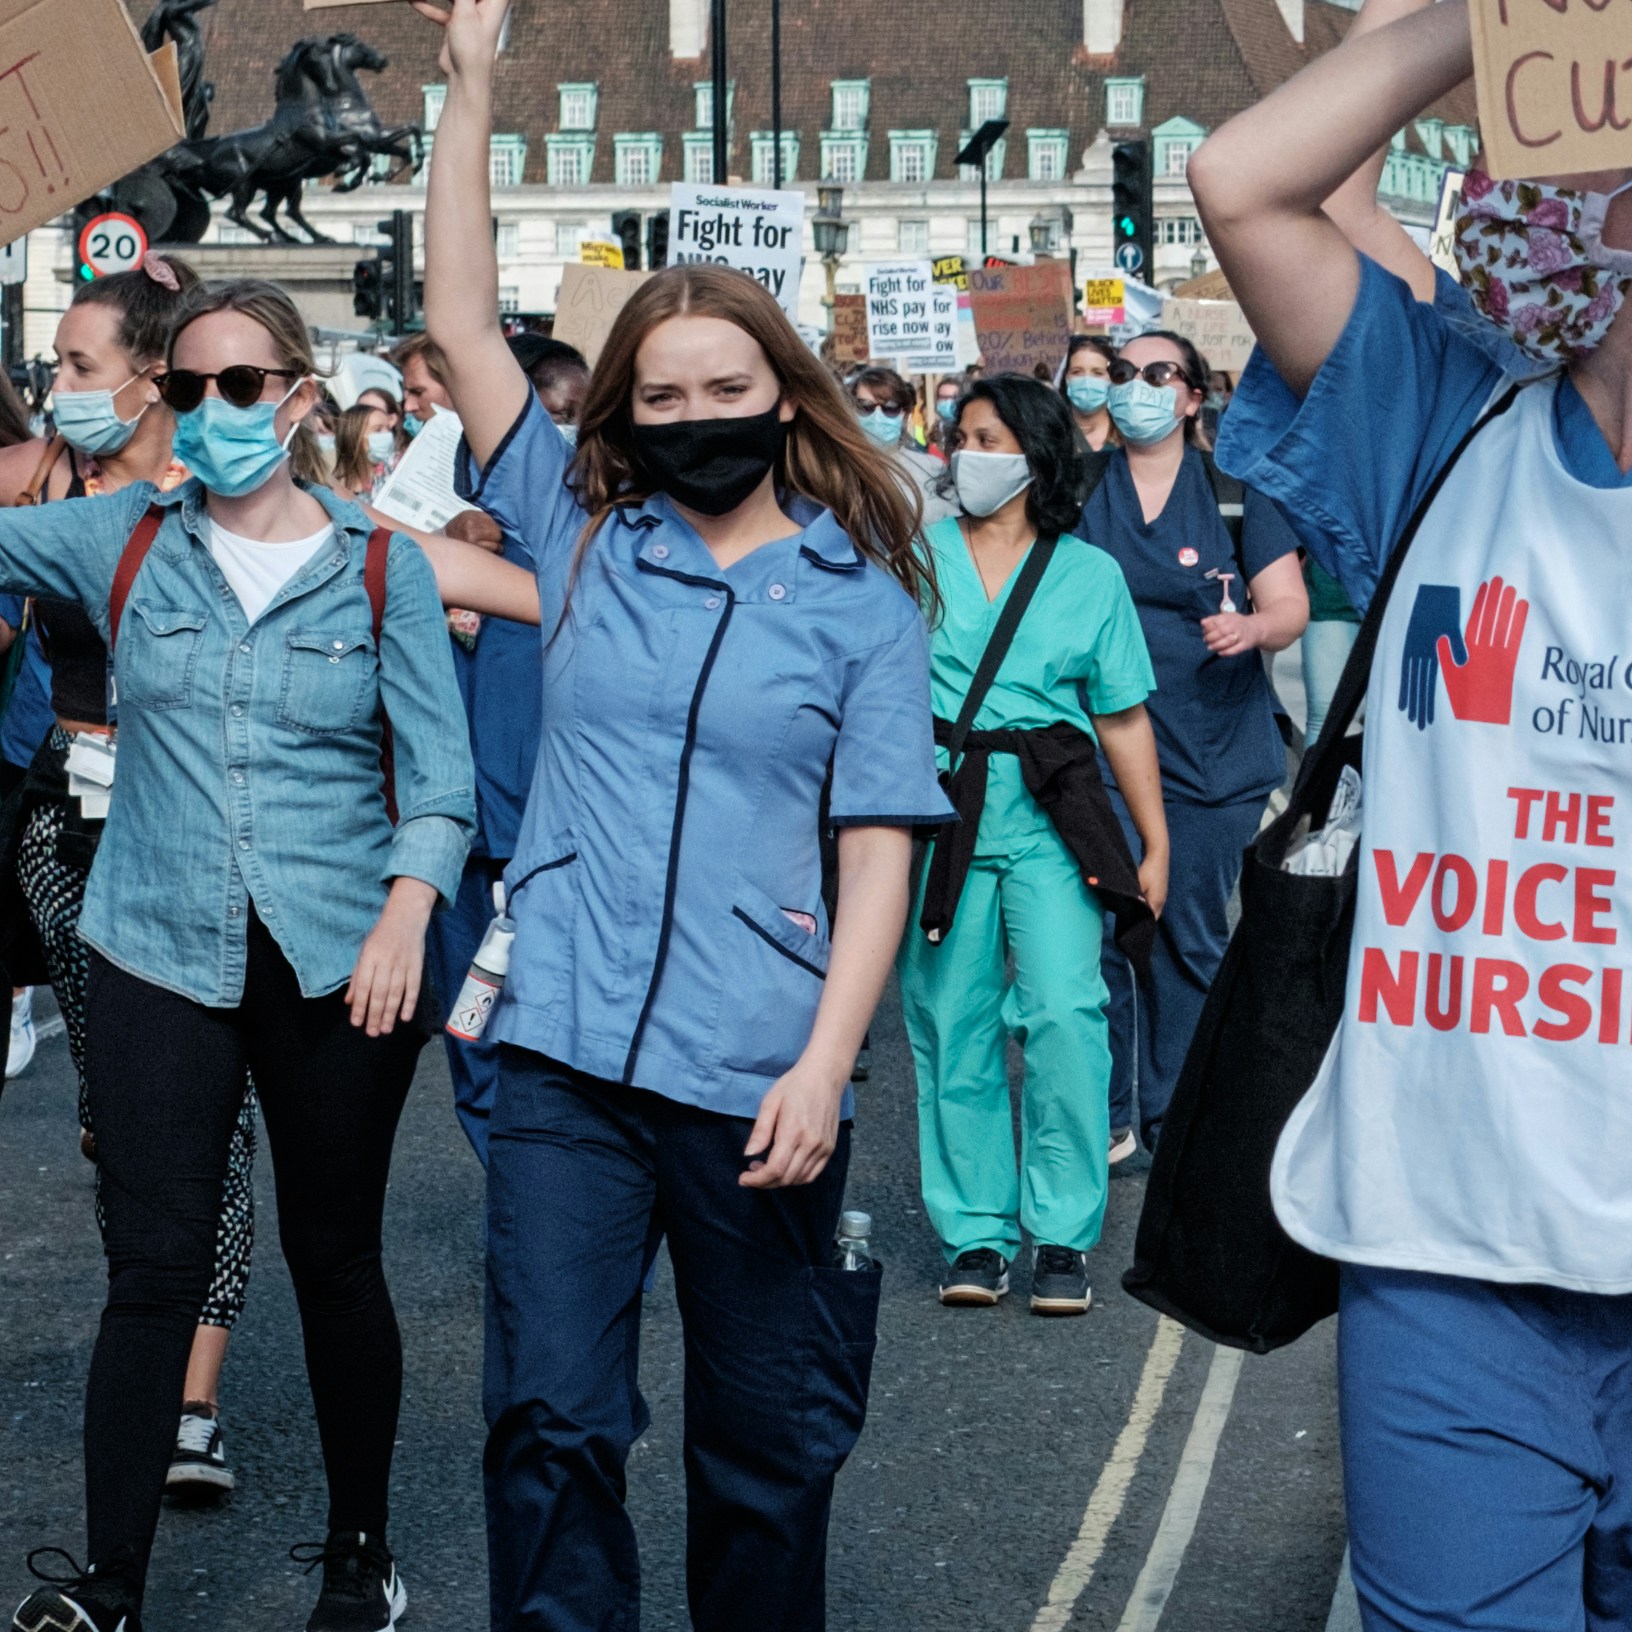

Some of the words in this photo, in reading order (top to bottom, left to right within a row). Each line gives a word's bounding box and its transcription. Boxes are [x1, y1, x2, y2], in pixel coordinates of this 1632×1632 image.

[696, 194, 740, 209] Socialist
[740, 200, 778, 211] Worker
[677, 209, 743, 251] Fight
[753, 216, 793, 249] for
[92, 234, 136, 260] 20
[869, 277, 902, 297] Fight
[906, 275, 926, 292] for
[871, 299, 898, 316] NHS
[903, 302, 926, 318] pay
[933, 298, 951, 313] for
[873, 319, 897, 335] rise
[903, 322, 929, 334] now
[934, 322, 951, 338] ay
[936, 340, 954, 352] ow
[1139, 386, 1167, 406] PAY
[1540, 646, 1618, 699] Royal
[1532, 698, 1574, 736] of
[1507, 786, 1615, 848] THE
[1372, 848, 1617, 946] VOICE
